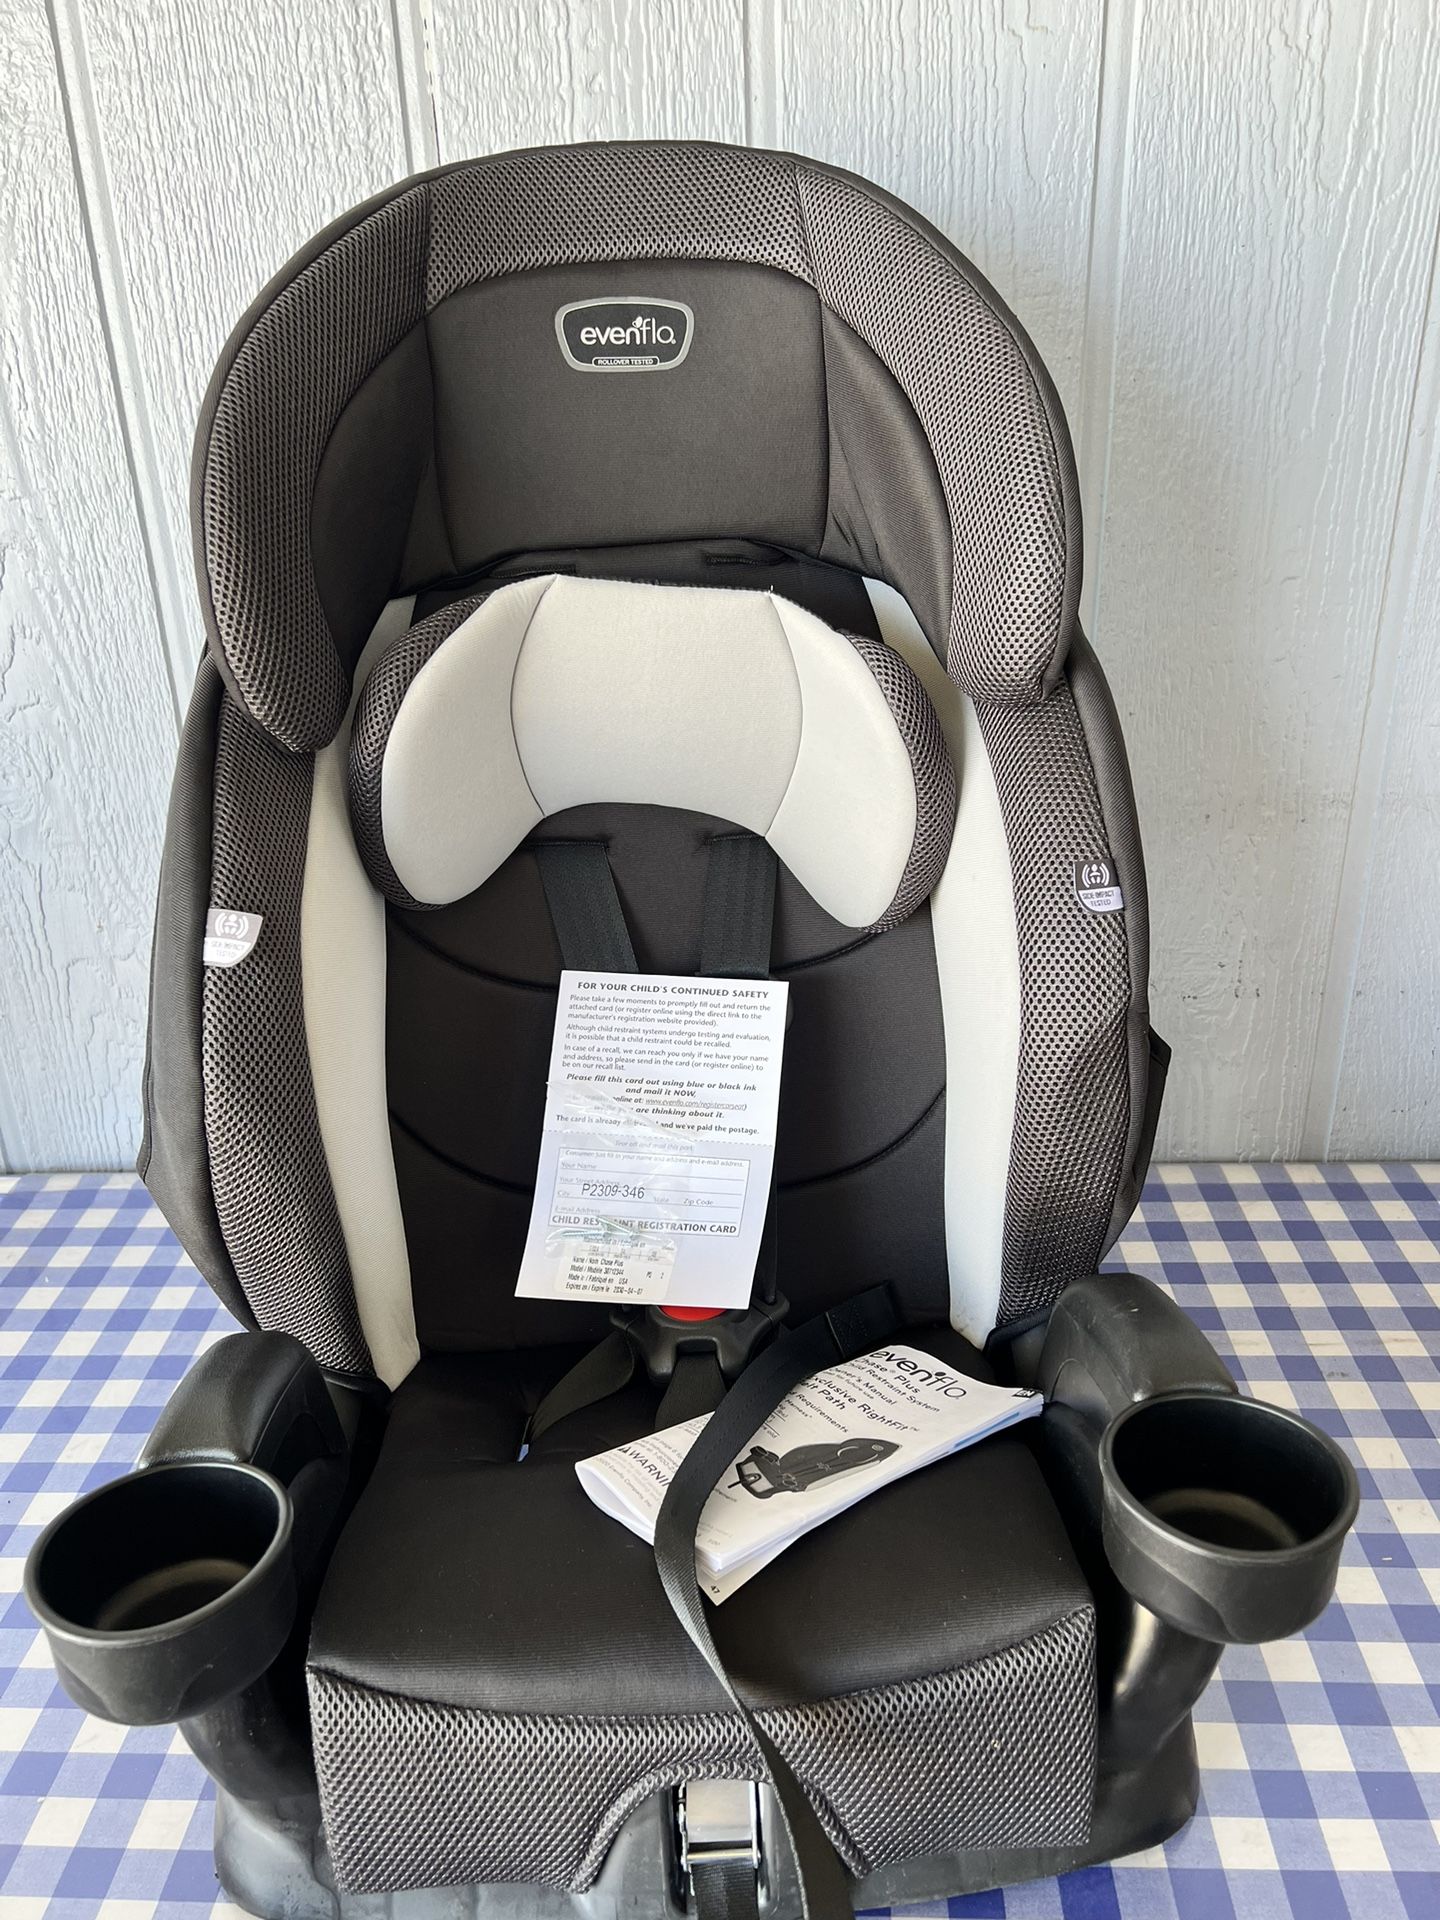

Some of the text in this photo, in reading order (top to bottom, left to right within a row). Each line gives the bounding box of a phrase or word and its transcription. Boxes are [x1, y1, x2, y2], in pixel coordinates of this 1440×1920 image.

[580, 316, 676, 345] evenflo
[599, 983, 626, 991] YOUR
[630, 984, 667, 993] CHILD'S
[670, 987, 728, 996] CONTINUED
[732, 990, 768, 998] SAFETY
[626, 1006, 650, 1014] register
[667, 999, 697, 1008] promptly
[567, 1012, 616, 1020] manufacturer's
[617, 1015, 654, 1023] registration
[683, 1018, 718, 1027] provided).
[566, 1024, 595, 1033] Although
[642, 1028, 666, 1036] systems
[668, 1029, 695, 1038] undergo
[697, 1031, 719, 1039] testing
[735, 1033, 770, 1042] evaluation,
[578, 1034, 604, 1042] possible
[602, 1047, 620, 1055] recall,
[577, 1055, 603, 1063] address,
[691, 1060, 701, 1068] (or
[703, 1061, 728, 1069] register
[730, 1062, 754, 1071] online)
[662, 1079, 683, 1088] using
[673, 1089, 696, 1098] NOW,
[651, 1108, 686, 1117] thinking
[595, 1117, 620, 1126] already
[696, 1124, 712, 1132] paid
[728, 1126, 759, 1135] postage.
[581, 1182, 645, 1198] P2309-346
[552, 1215, 736, 1233] CHILD REGISTRATION CARD
[869, 1351, 966, 1398] evenflo
[866, 1369, 940, 1412] Restraint System
[894, 1375, 920, 1394] Plus
[818, 1389, 846, 1410] Path
[863, 1382, 898, 1405] Manual
[796, 1394, 848, 1433] Requirements
[629, 1450, 671, 1487] WARNI
